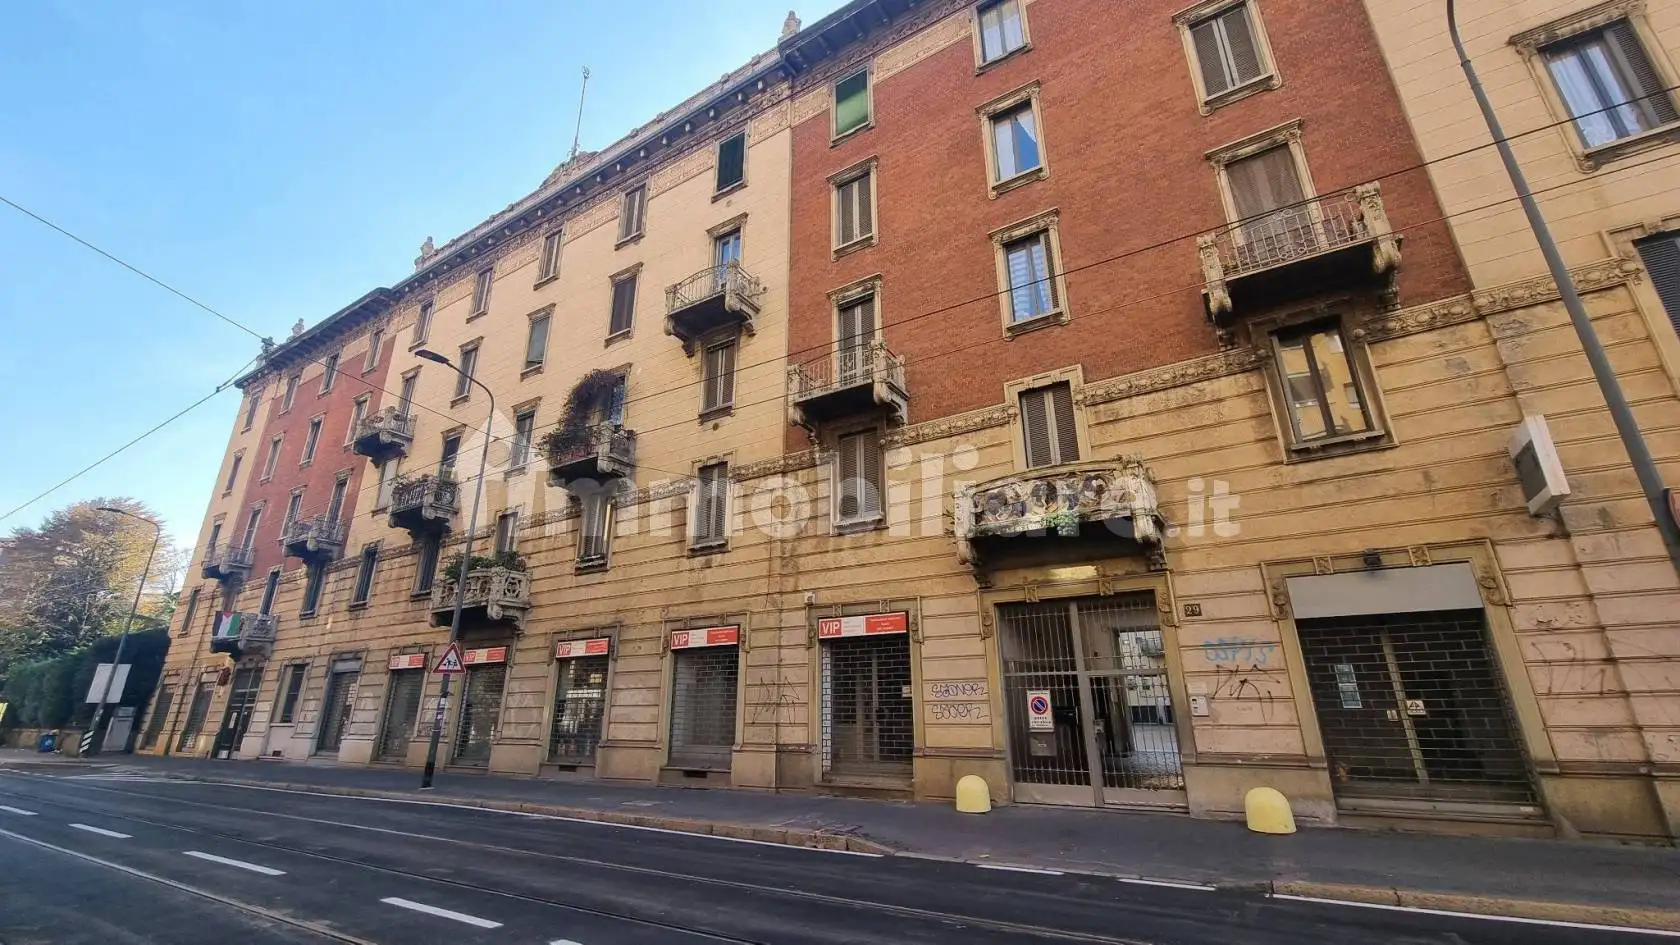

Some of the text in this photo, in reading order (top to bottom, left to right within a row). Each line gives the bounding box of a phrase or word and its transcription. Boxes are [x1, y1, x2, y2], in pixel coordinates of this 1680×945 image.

[1184, 604, 1200, 617] 29
[821, 620, 841, 634] VIP
[673, 633, 688, 646] VIP
[559, 643, 572, 656] VIP
